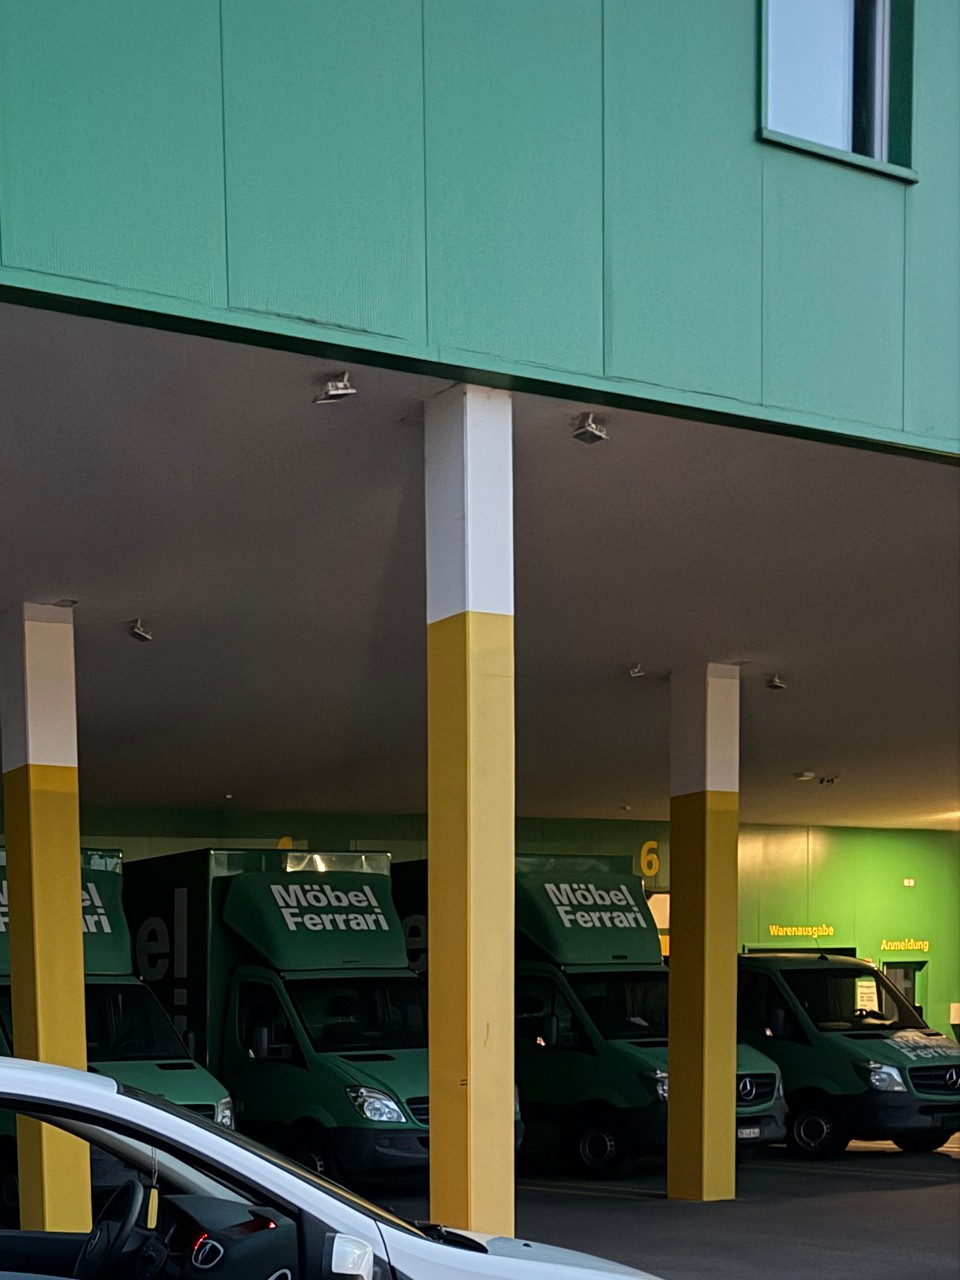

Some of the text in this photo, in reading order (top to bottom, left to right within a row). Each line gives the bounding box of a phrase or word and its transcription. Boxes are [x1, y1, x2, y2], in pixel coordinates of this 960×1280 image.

[640, 840, 660, 877] 6
[270, 884, 379, 908] Möbel
[544, 883, 636, 906] Möbel
[281, 907, 390, 931] Ferrari
[555, 905, 648, 929] Ferrari
[769, 923, 835, 938] Warenausgabe
[880, 939, 930, 952] Anmeldung
